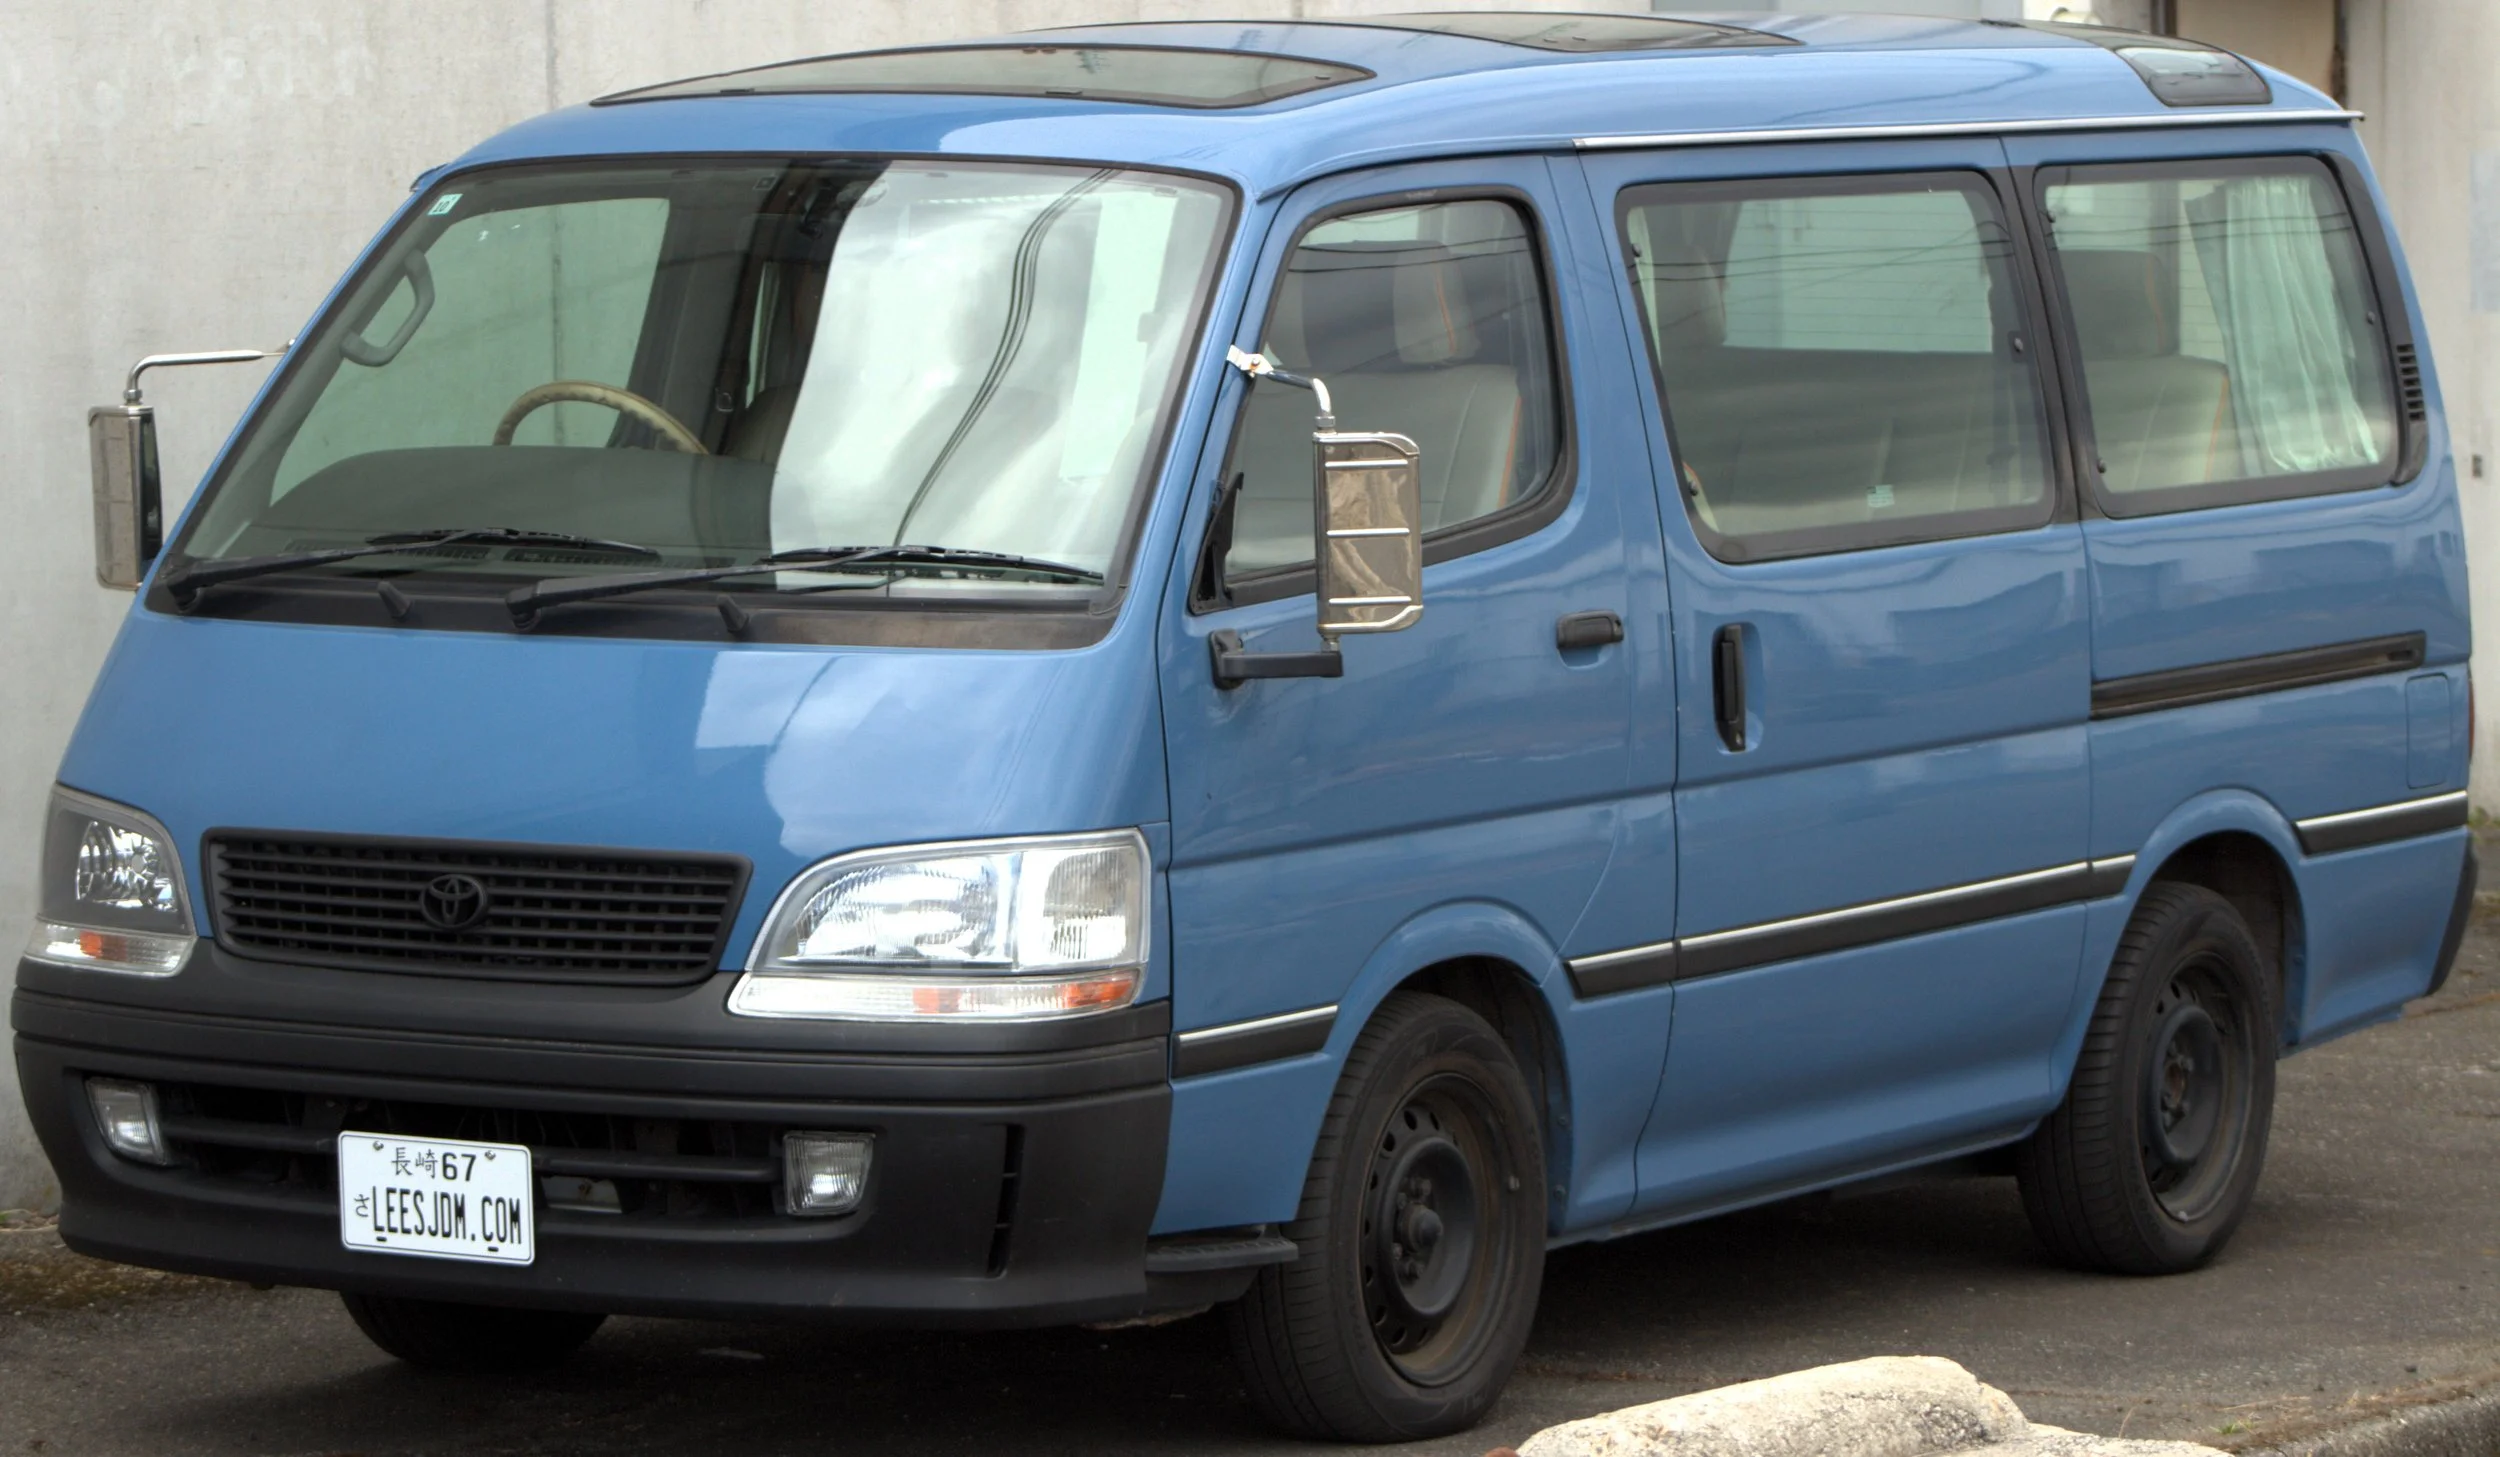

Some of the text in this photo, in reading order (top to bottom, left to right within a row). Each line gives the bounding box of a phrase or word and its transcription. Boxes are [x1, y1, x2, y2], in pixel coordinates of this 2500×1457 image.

[391, 1146, 476, 1182] 長崎 67
[354, 1185, 522, 1245] さ LEESJDM.COM
